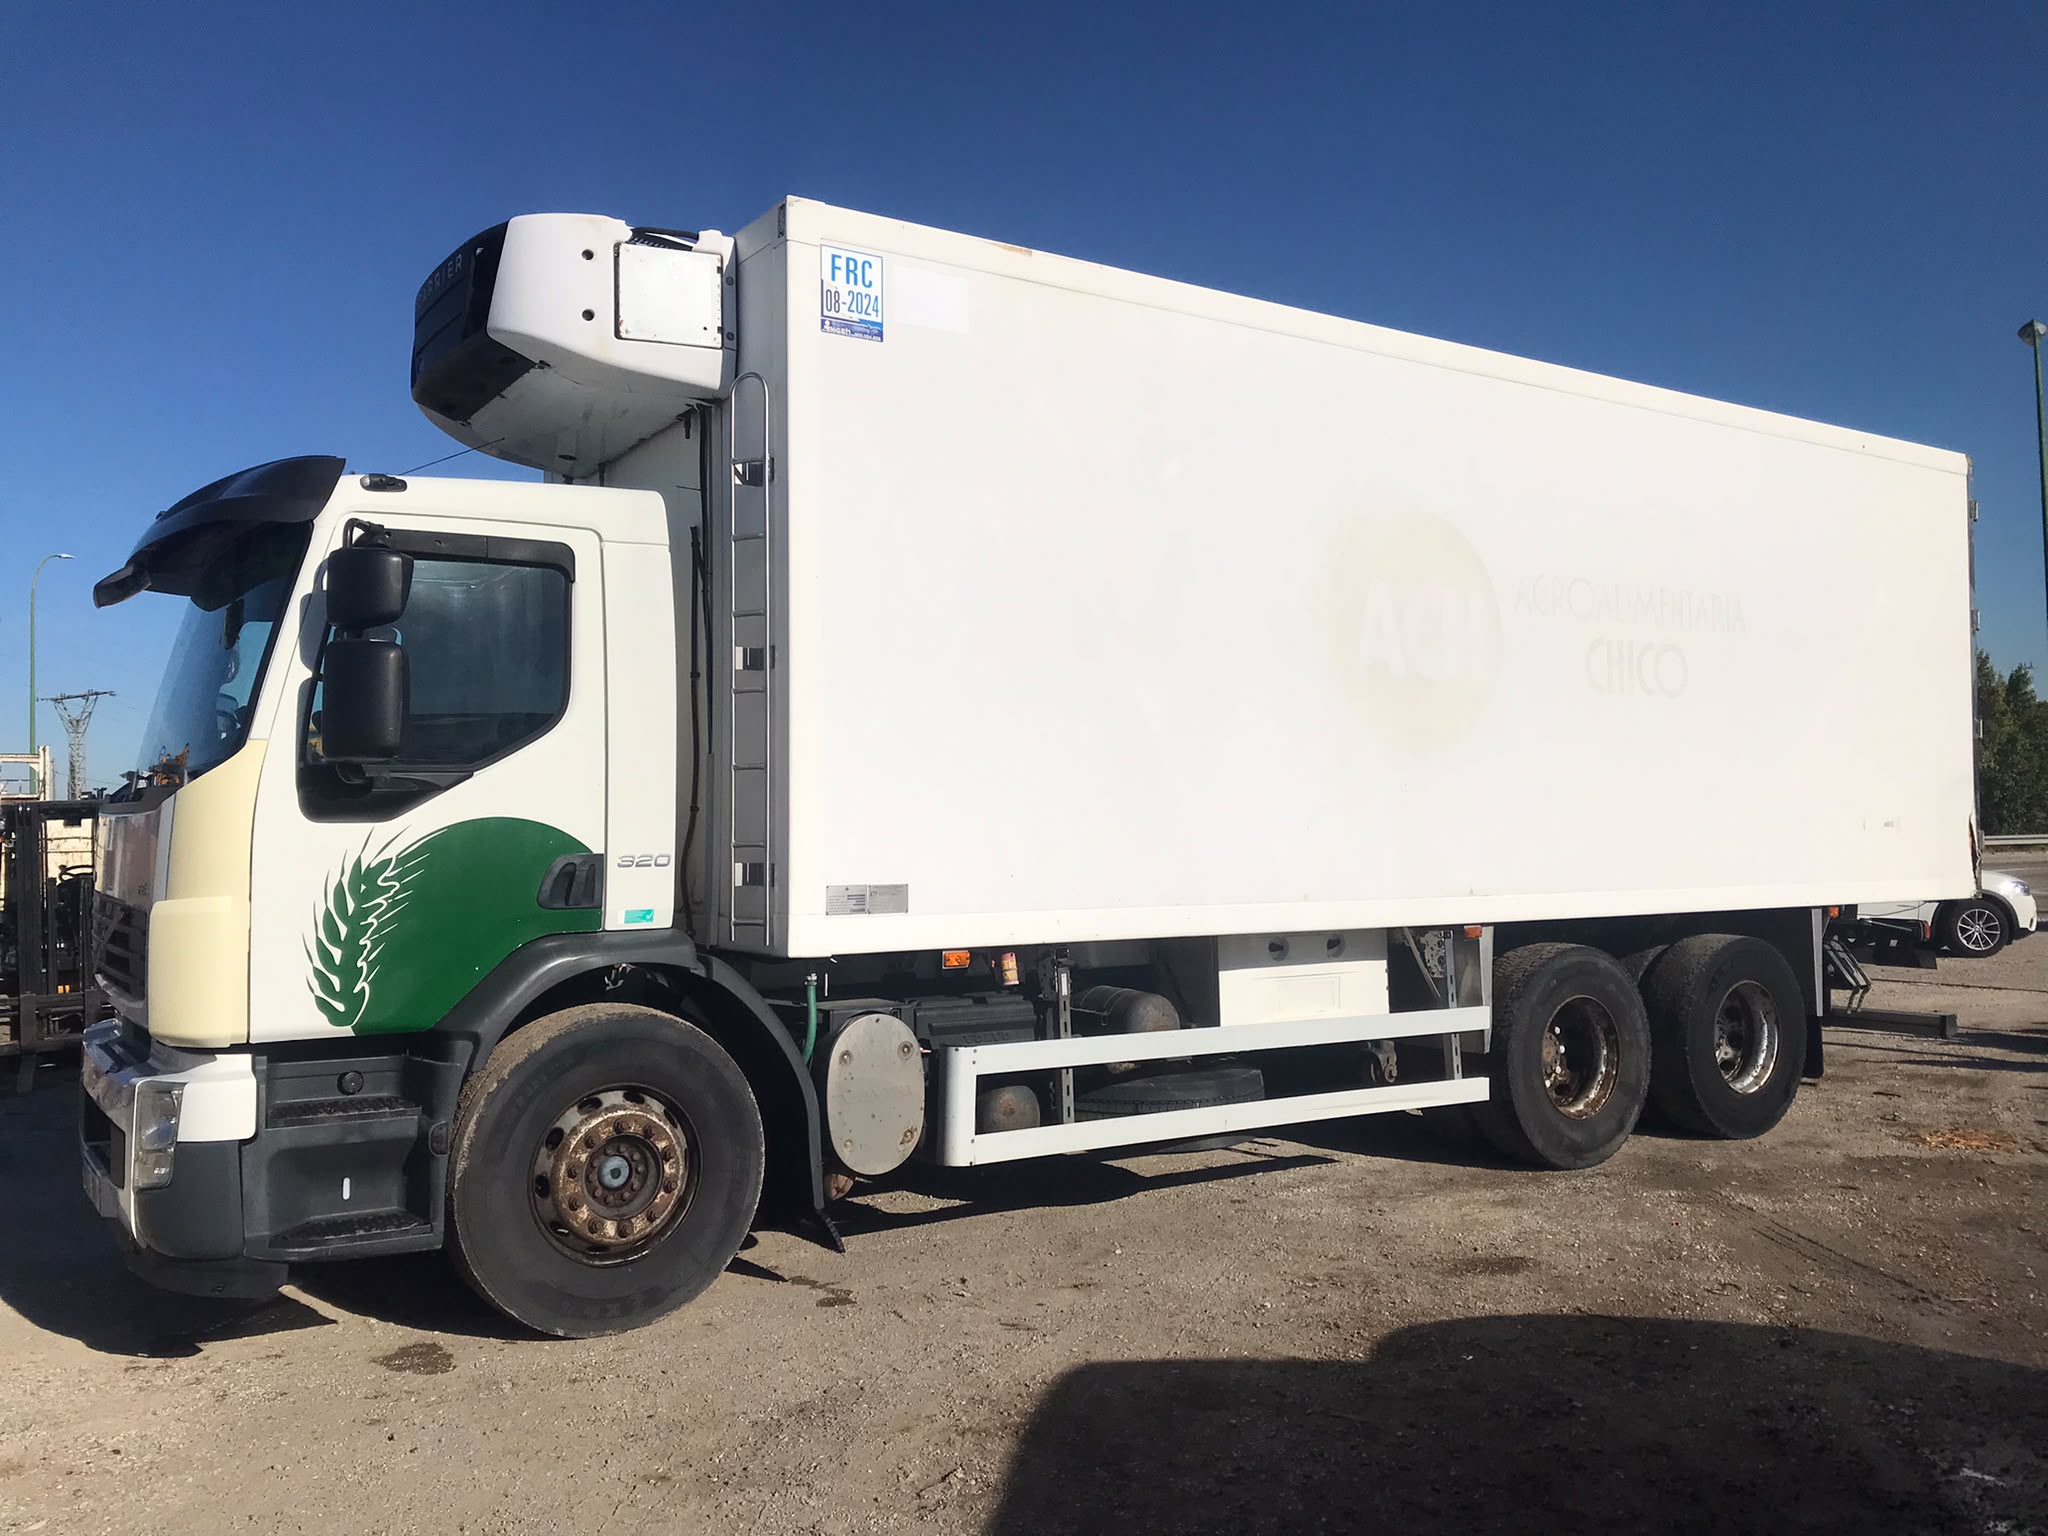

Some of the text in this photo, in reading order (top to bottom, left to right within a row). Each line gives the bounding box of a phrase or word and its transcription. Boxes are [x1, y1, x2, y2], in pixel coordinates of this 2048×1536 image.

[831, 254, 873, 289] FRC
[825, 288, 880, 318] 08-2024
[1513, 573, 1748, 635] AGROALIMENTARIA
[1585, 635, 1689, 699] CHICO
[617, 854, 671, 868] 320
